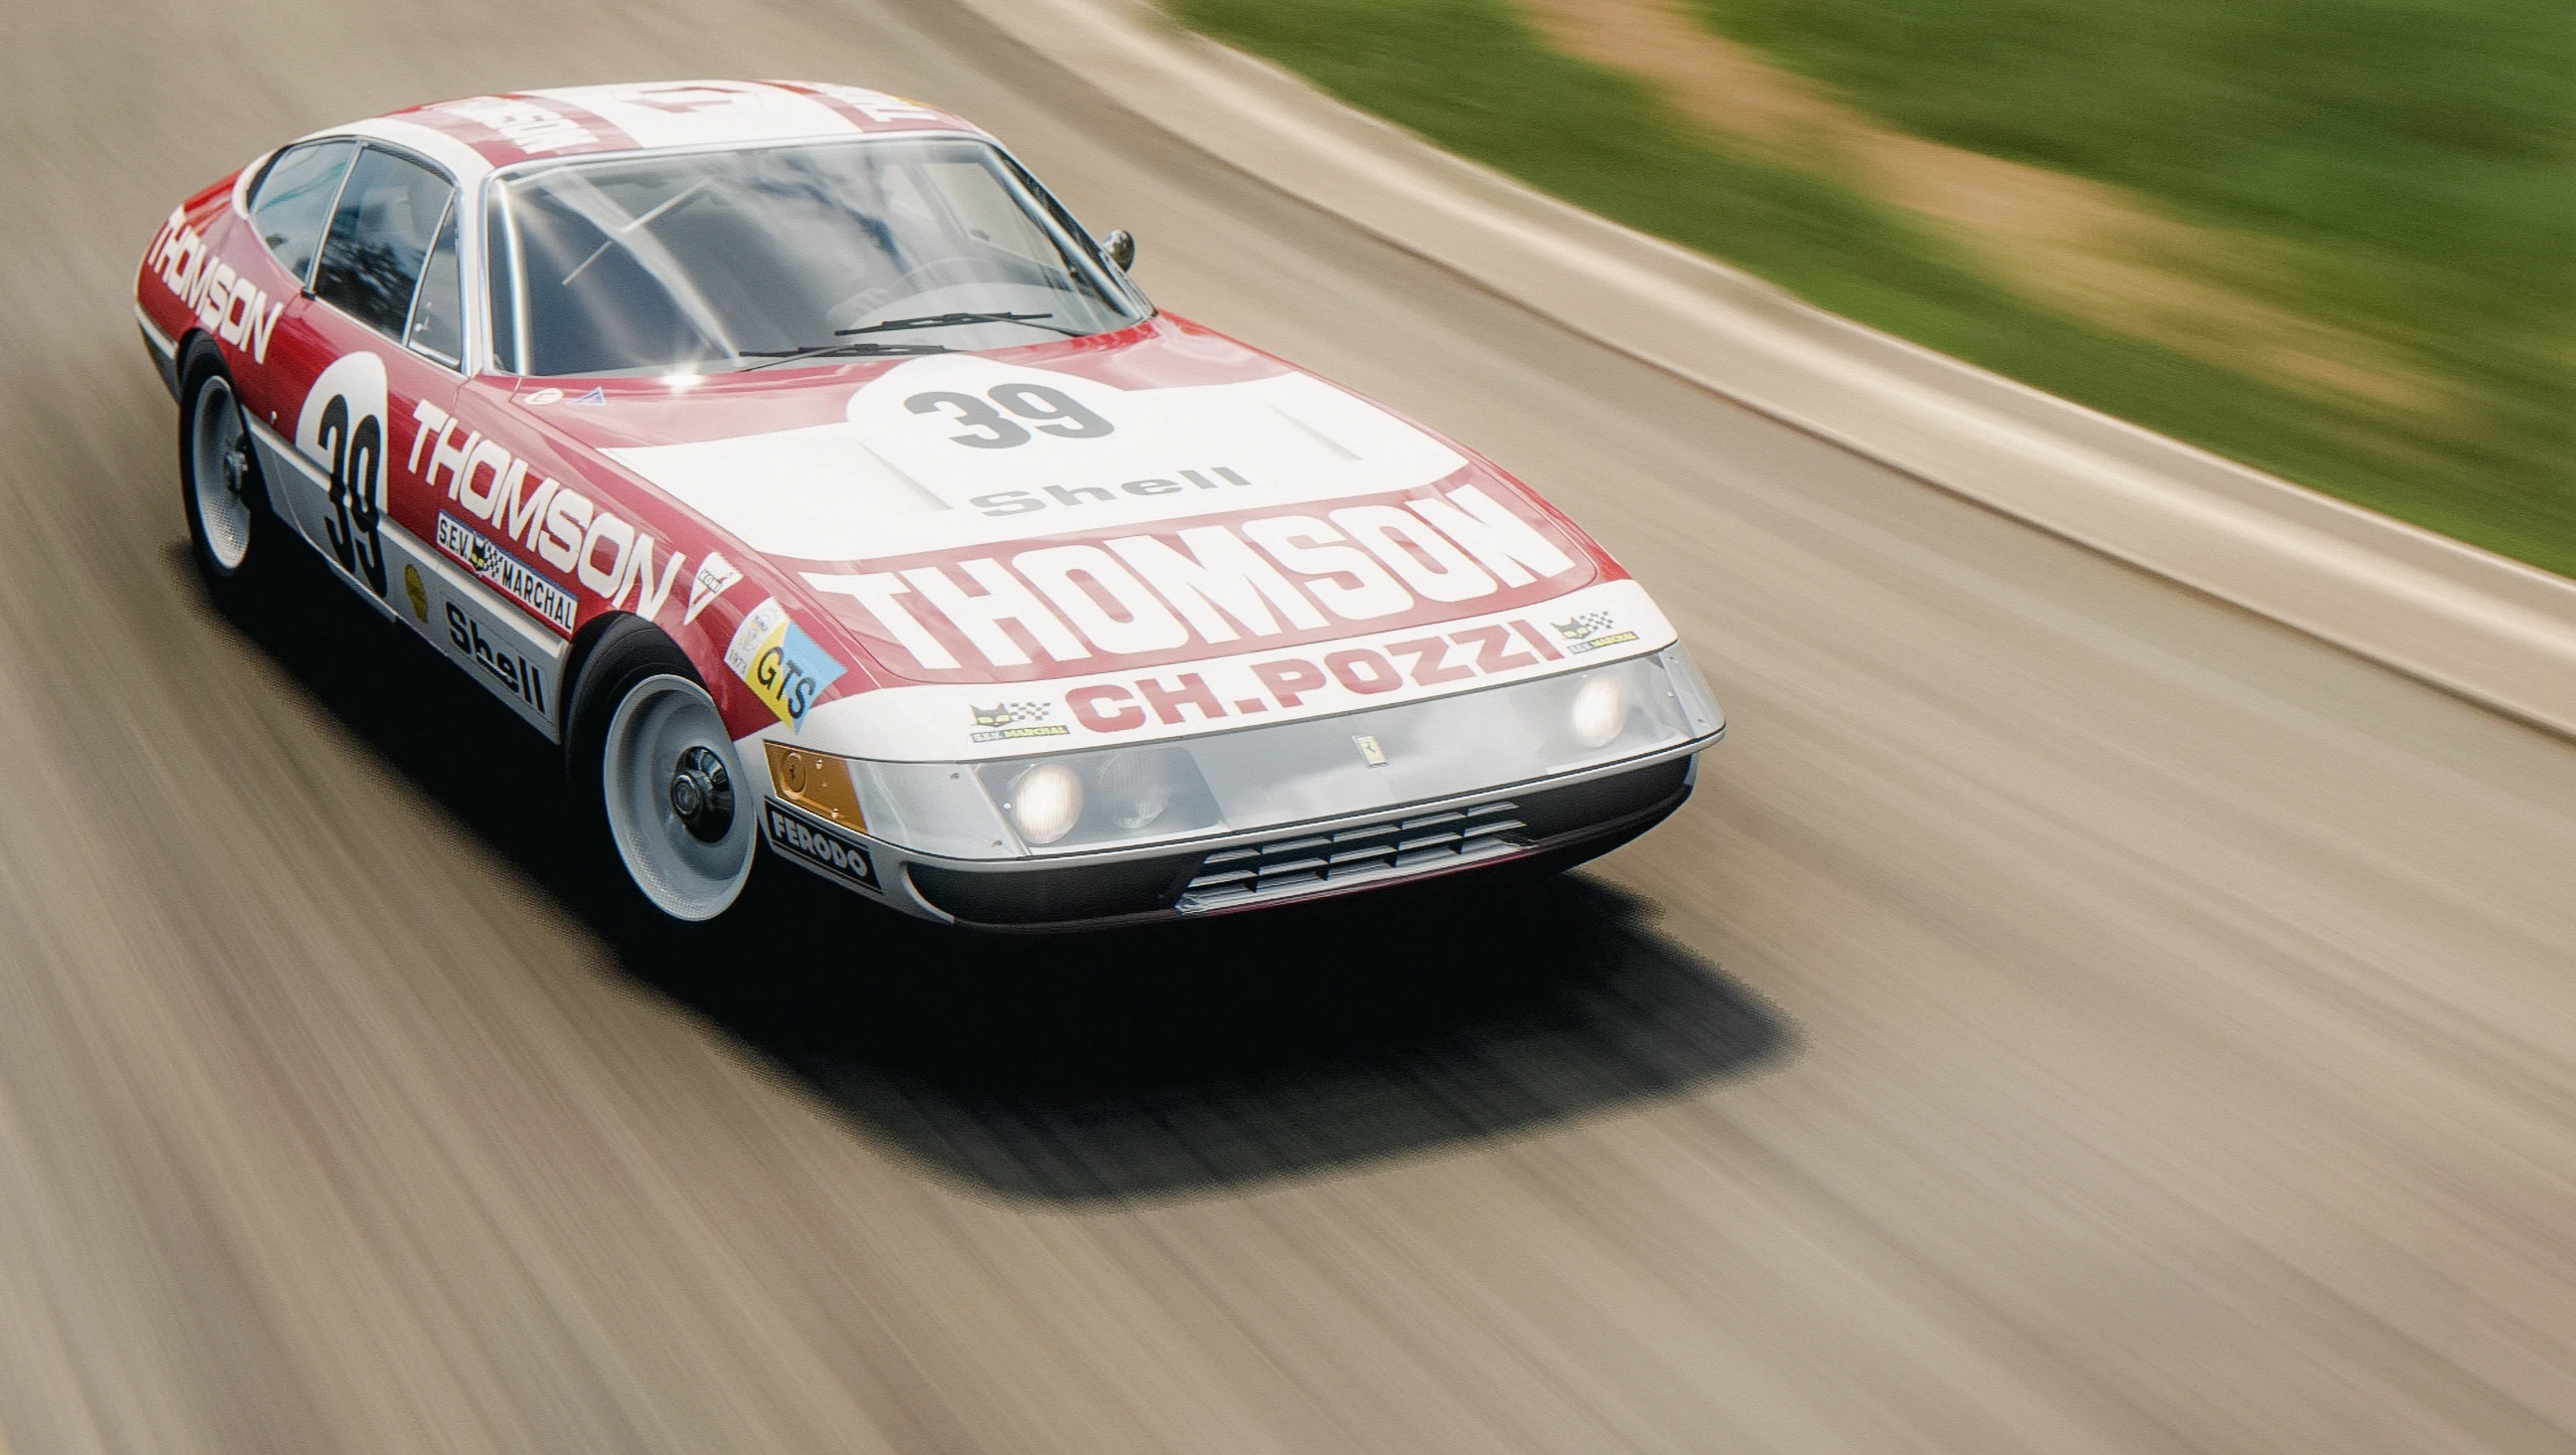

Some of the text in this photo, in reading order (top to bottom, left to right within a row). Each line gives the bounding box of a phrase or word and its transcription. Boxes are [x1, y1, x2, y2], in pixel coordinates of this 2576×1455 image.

[146, 203, 284, 365] THOMSON
[904, 384, 1115, 450] 39
[318, 394, 388, 598] 39
[407, 399, 687, 623] THOMSON
[969, 465, 1253, 517] Shell
[501, 559, 572, 631] MARCHAL
[806, 482, 1575, 670] THOMSON
[445, 601, 547, 715] Shell
[728, 648, 748, 674] 1973
[758, 646, 816, 719] GTS
[770, 812, 868, 878] FERODO
